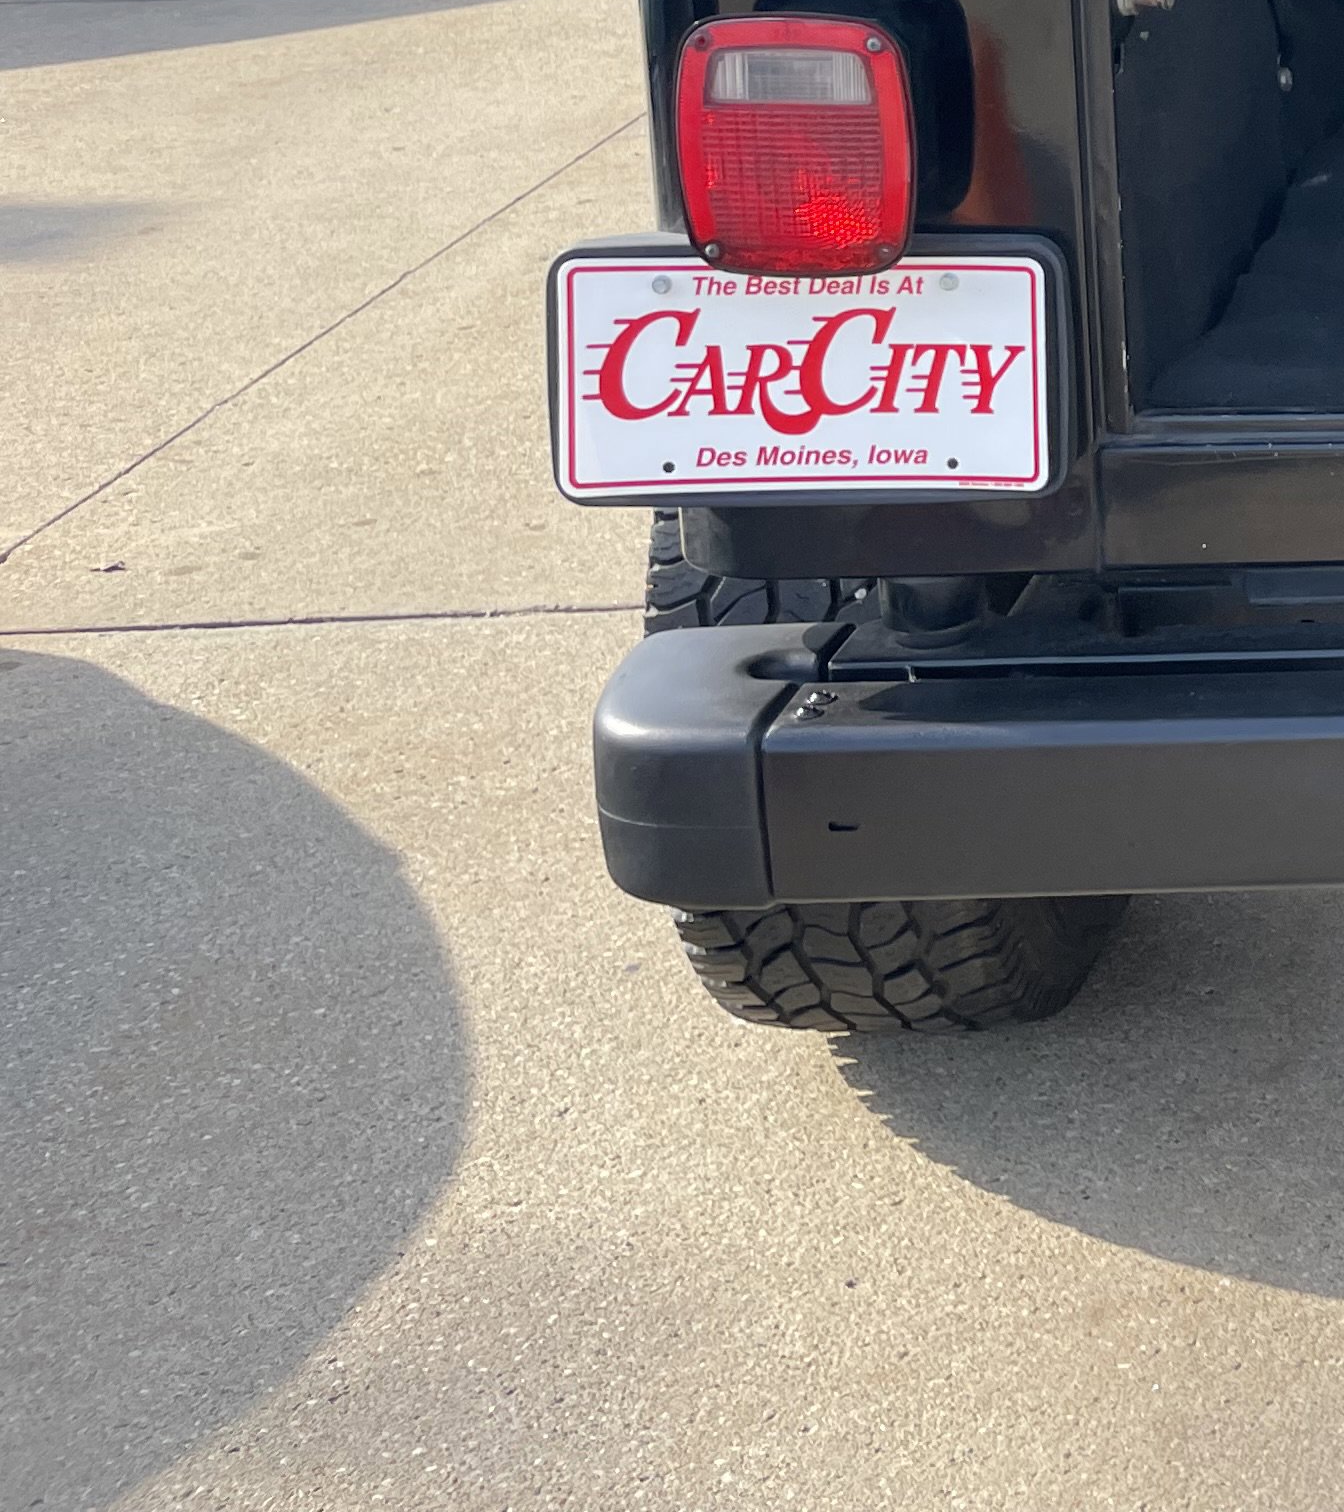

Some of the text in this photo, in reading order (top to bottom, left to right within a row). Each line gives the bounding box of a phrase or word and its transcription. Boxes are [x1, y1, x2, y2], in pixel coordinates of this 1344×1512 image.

[692, 274, 924, 296] The Best Deal Is At
[695, 445, 929, 469] Des Moines, Iowa
